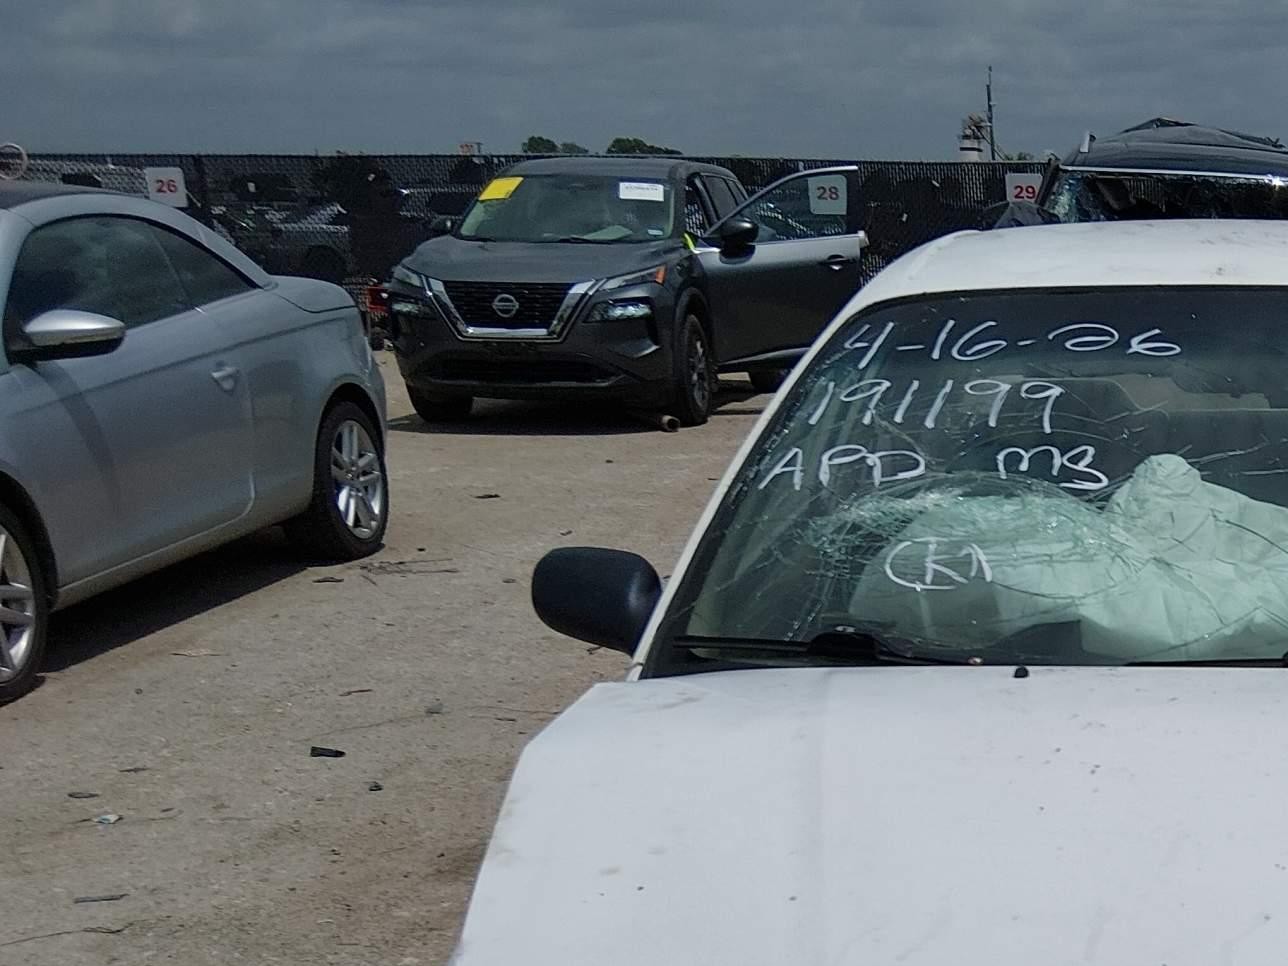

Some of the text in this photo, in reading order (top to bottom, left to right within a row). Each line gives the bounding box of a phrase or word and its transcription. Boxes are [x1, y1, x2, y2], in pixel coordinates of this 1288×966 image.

[155, 179, 177, 193] 26
[816, 186, 839, 200] 28
[1014, 185, 1036, 199] 29
